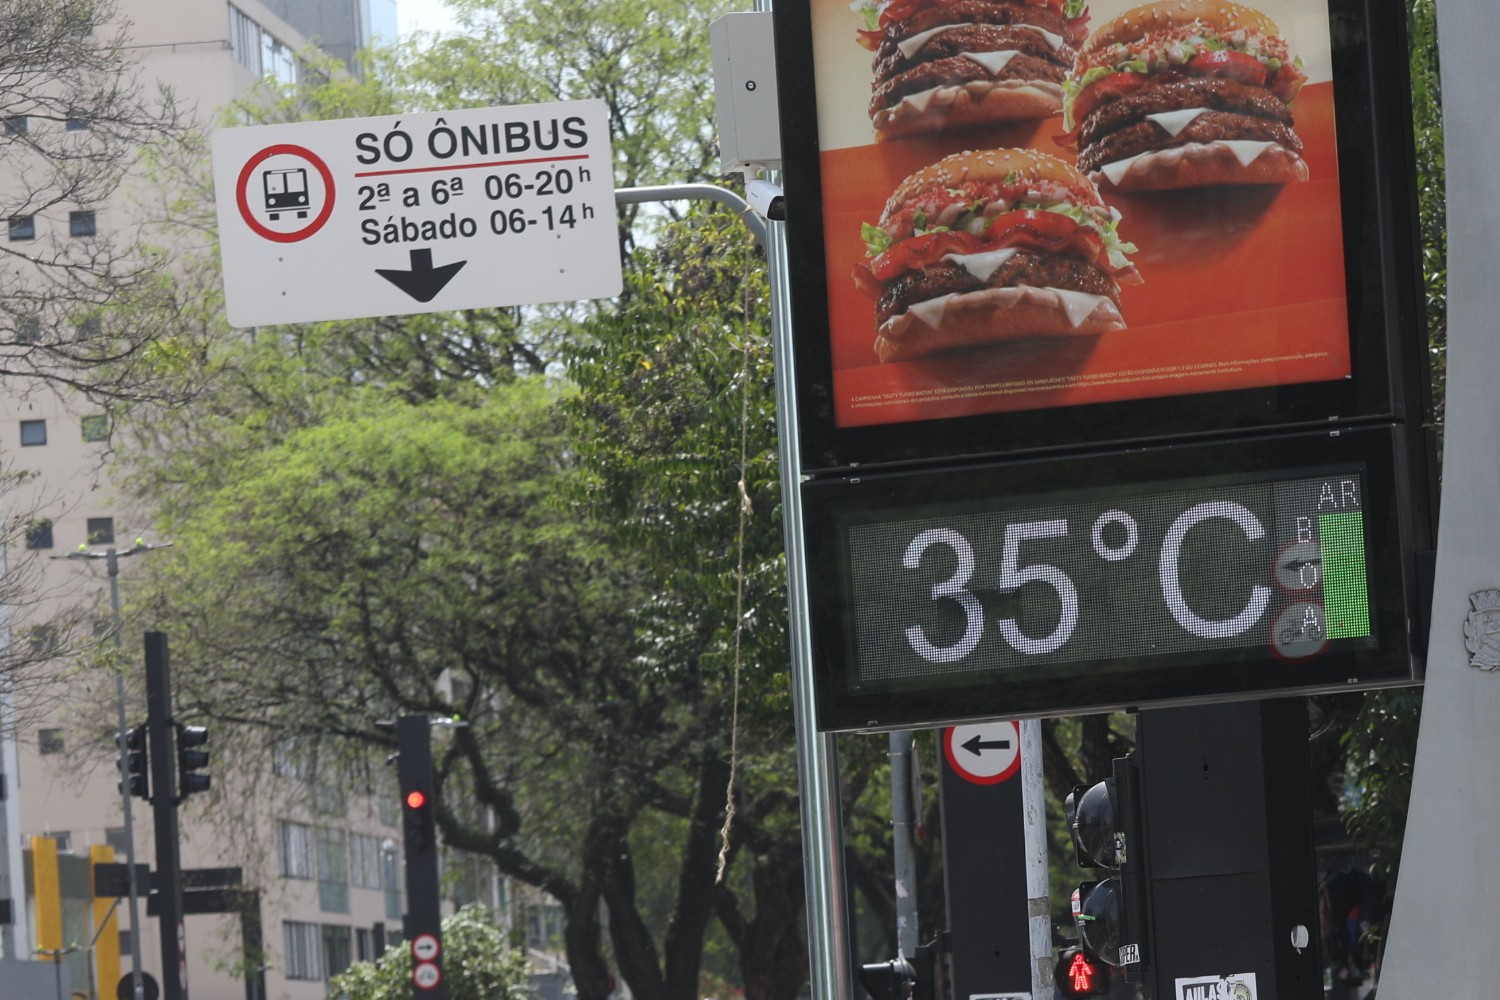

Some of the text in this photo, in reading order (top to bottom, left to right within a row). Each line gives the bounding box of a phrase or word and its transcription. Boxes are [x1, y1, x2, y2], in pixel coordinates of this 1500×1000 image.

[355, 117, 589, 164] SÓ ÔNIBUS
[358, 182, 391, 210] 2ª
[402, 186, 420, 207] a
[431, 176, 464, 205] 6ª
[361, 213, 477, 245] Sábado
[1318, 480, 1357, 509] AR
[903, 501, 1271, 663] 35°C
